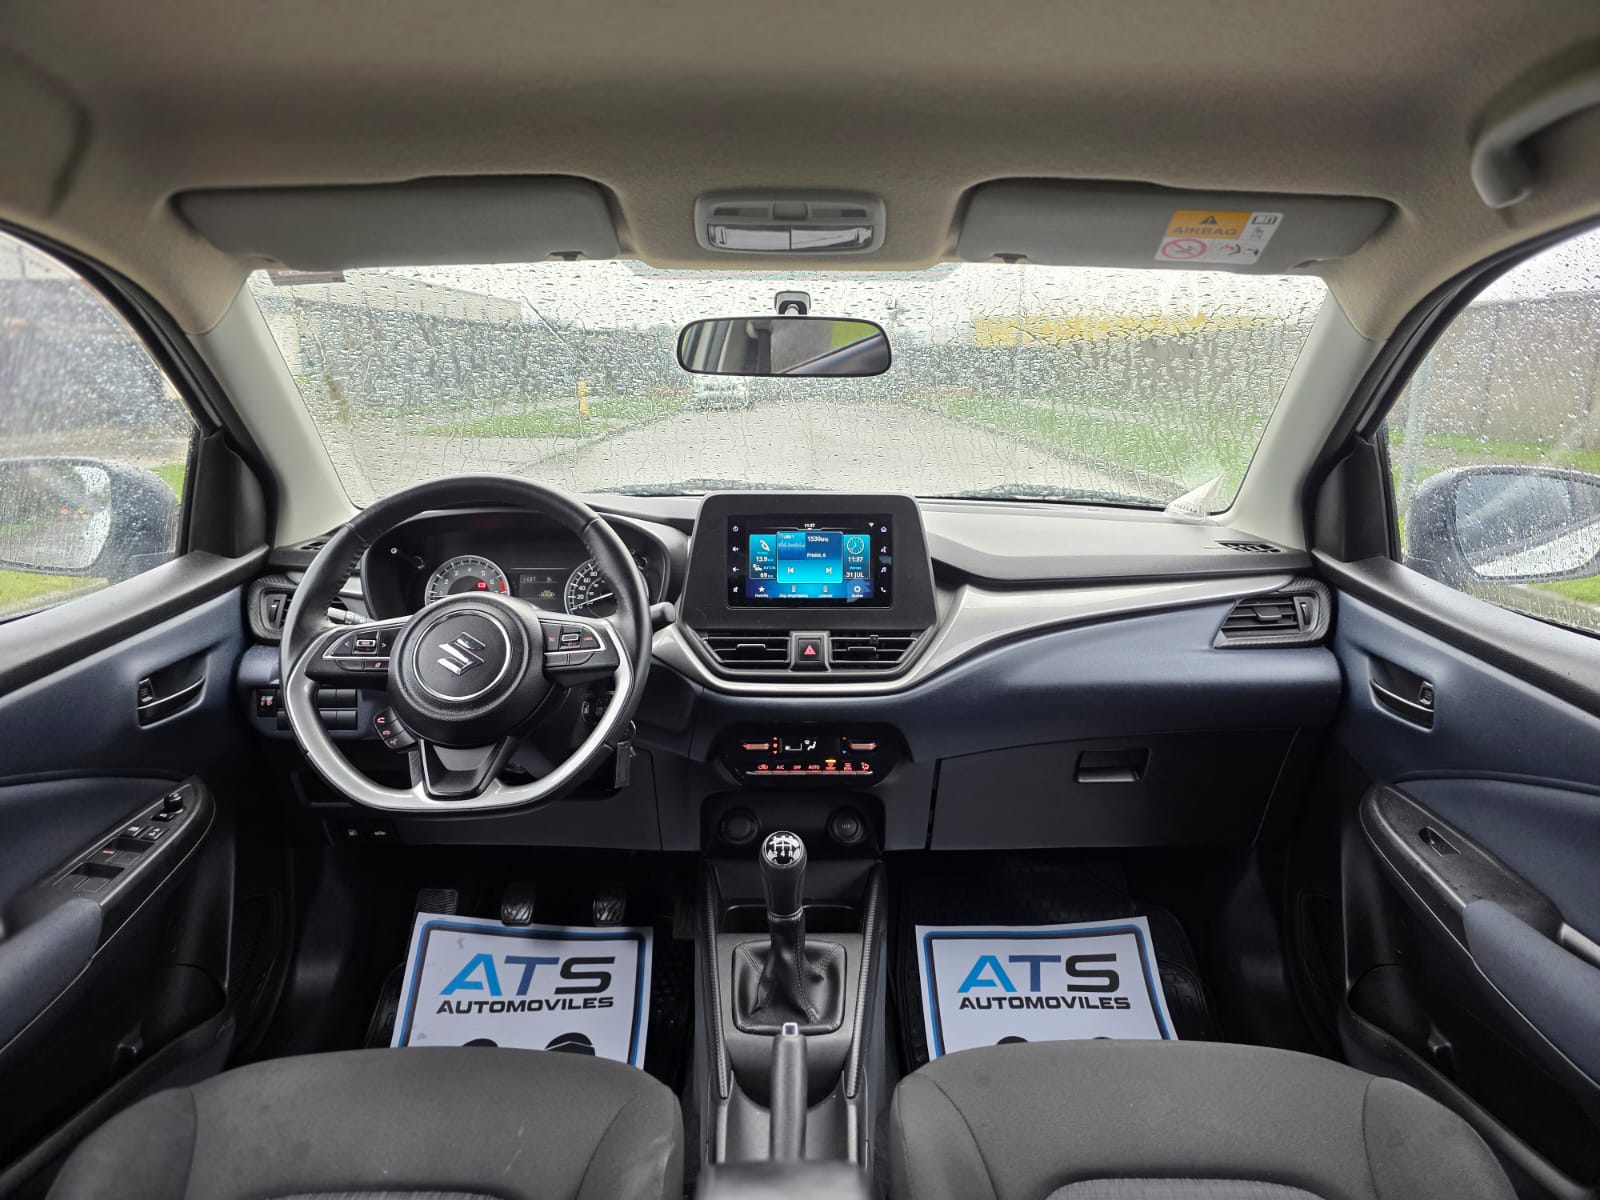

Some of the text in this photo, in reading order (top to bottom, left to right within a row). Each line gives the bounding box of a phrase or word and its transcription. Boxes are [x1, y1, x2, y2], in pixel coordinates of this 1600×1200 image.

[1173, 226, 1237, 236] AIRBAG
[439, 953, 616, 997] ATS
[957, 953, 1120, 993] ATS
[436, 997, 614, 1014] AUTOMOVILES
[959, 996, 1131, 1010] AUTOMOVILES
